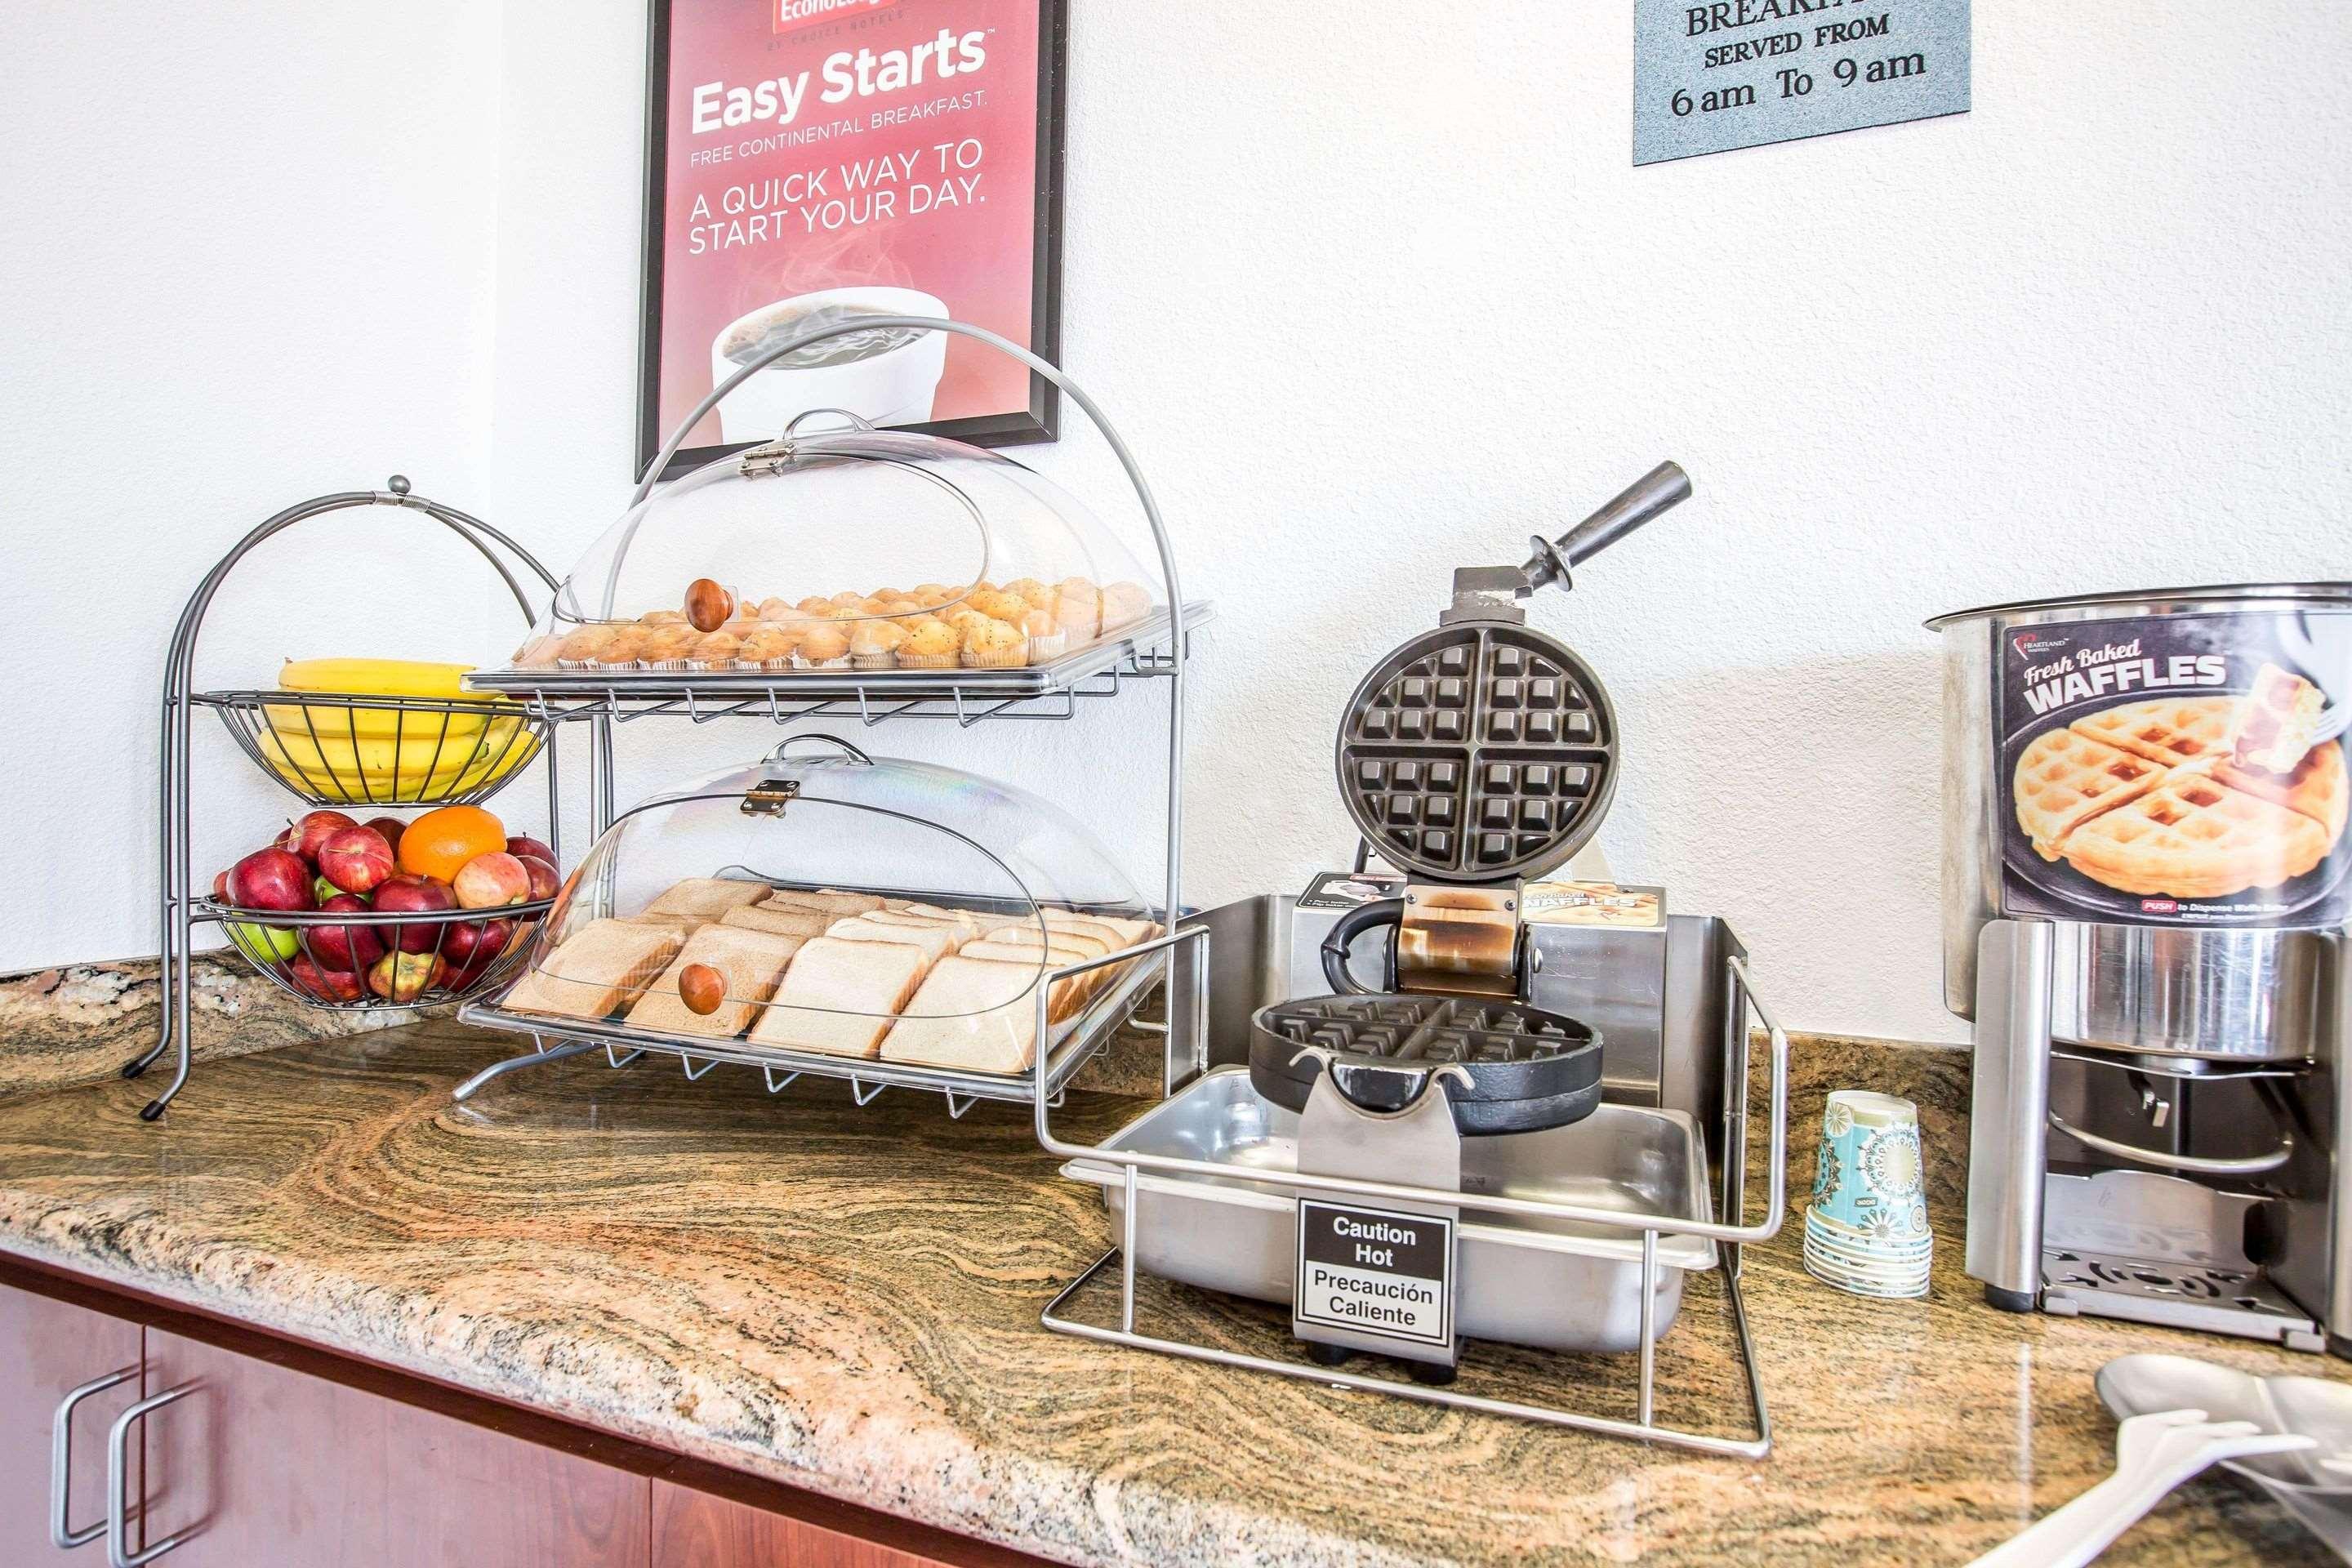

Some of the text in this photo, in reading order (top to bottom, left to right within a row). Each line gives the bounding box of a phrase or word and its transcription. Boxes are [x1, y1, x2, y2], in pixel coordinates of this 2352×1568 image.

[1704, 14, 1890, 69] SERVED FROM
[692, 71, 810, 134] Easy
[1775, 68, 1814, 99] To
[690, 90, 988, 168] FREE CONTINENTAL BREAKFAST.
[689, 138, 983, 223] A QUICK WAY TO
[688, 173, 986, 255] START YOUR DAY.
[2023, 638, 2142, 687] Fresh Baked
[2023, 655, 2226, 715] WAFFLES
[2144, 900, 2174, 911] PUSH
[2177, 903, 2189, 911] to
[1332, 1215, 1417, 1246] Caution
[1354, 1243, 1394, 1267] Hot
[1314, 1268, 1433, 1305] Precaución
[1329, 1295, 1417, 1326] Caliente
